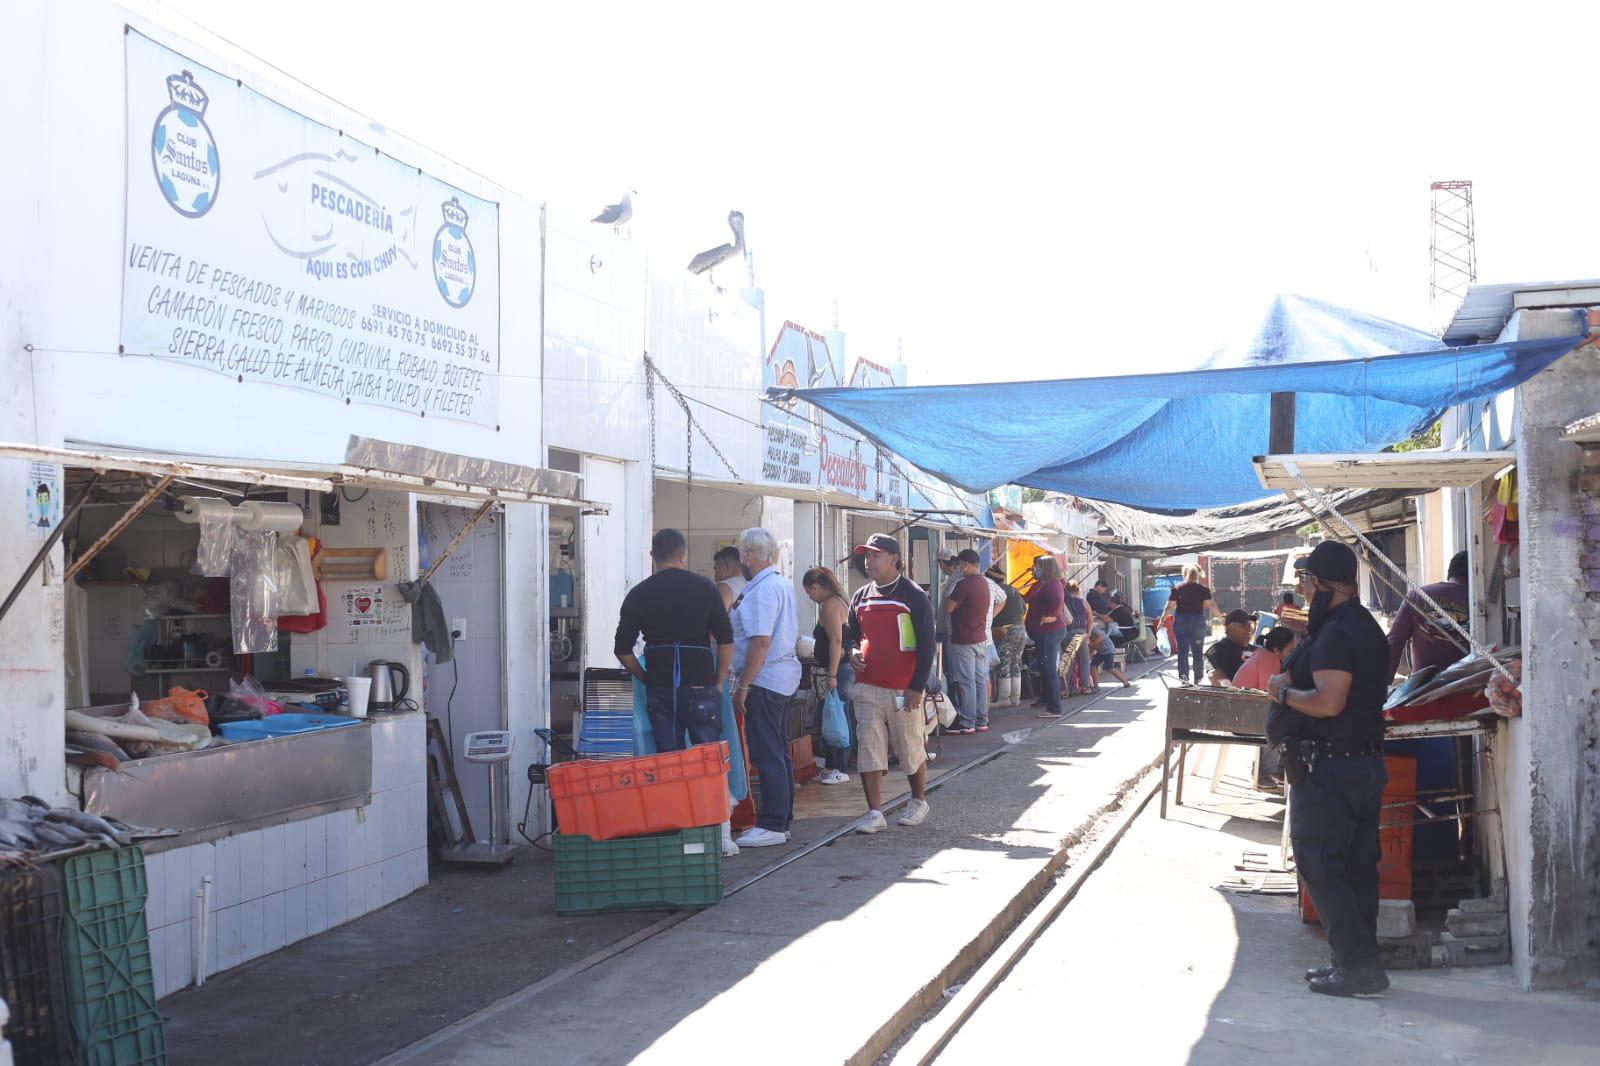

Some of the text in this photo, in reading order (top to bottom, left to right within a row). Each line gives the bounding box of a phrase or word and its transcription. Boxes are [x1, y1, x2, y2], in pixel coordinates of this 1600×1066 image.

[162, 138, 208, 174] Santos
[177, 133, 197, 148] CLUB
[171, 168, 201, 186] LAGUNA
[311, 183, 394, 234] PESCADERÍA
[306, 244, 397, 280] AQUI ES CON CHUY
[440, 249, 468, 274] Santos
[448, 243, 461, 255] CLUB
[129, 243, 181, 279] VENTA
[186, 260, 209, 285] DE
[210, 268, 281, 307] PESCADOS
[296, 294, 357, 330] MARISCOS
[147, 285, 227, 330] CAMARÓN
[230, 308, 284, 349] FRESCO,
[371, 303, 479, 346] SERVICIO A DOMICILIO AL
[361, 317, 383, 335] 6691
[387, 324, 399, 339] 45
[401, 328, 413, 343] 70
[415, 331, 426, 347] 75
[431, 336, 452, 353] 6692
[456, 342, 465, 357] 55
[468, 346, 478, 360] 37
[274, 352, 296, 378] DE
[385, 378, 421, 408] PULPO
[432, 388, 474, 416] FILETES
